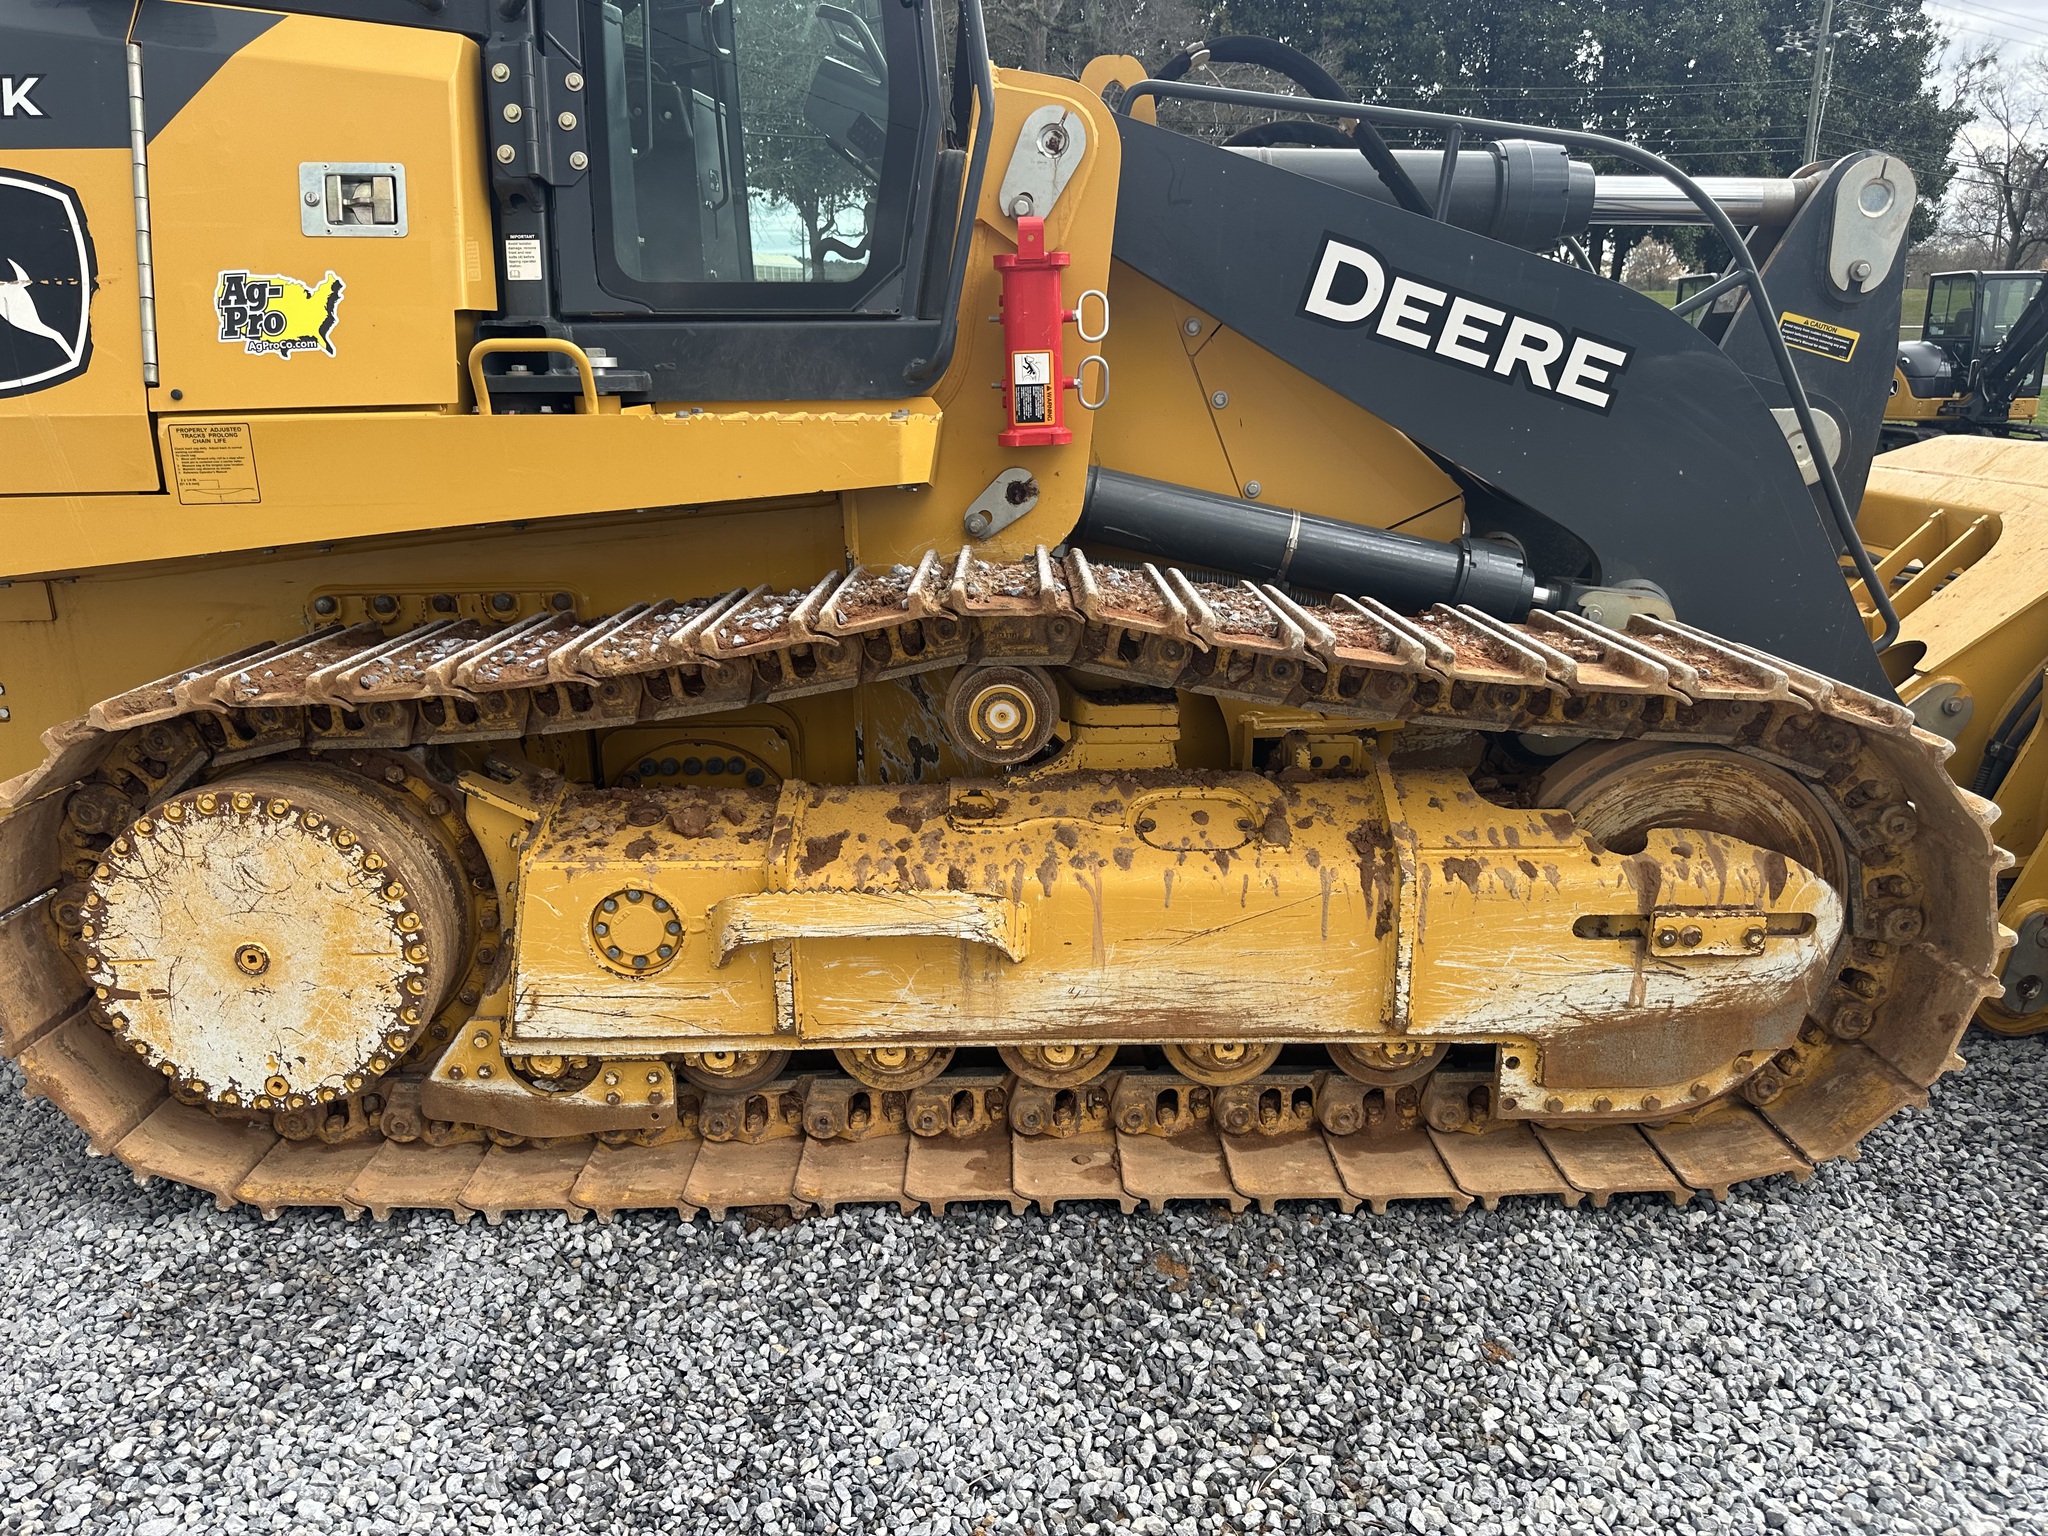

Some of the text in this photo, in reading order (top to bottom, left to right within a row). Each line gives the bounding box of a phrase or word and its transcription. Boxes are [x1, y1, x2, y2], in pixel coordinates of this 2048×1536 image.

[2, 78, 43, 116] K
[220, 274, 282, 312] Ag-
[222, 306, 286, 339] Pro
[1305, 240, 1626, 408] DEERE
[1810, 321, 1837, 333] CAUTION
[248, 341, 317, 352] AgProCo.com
